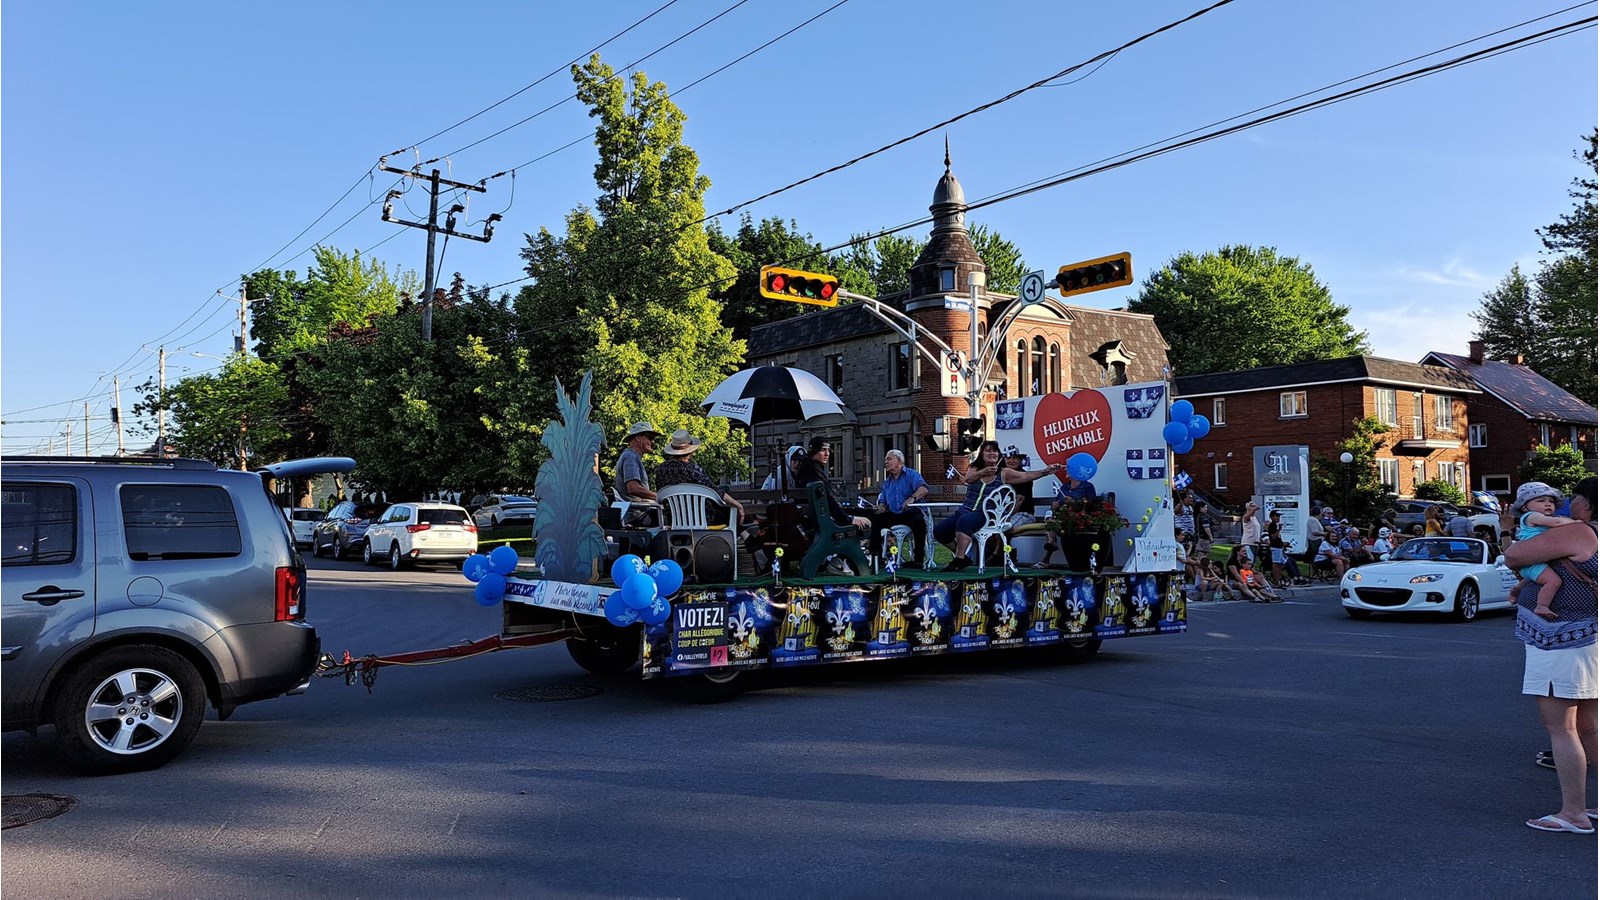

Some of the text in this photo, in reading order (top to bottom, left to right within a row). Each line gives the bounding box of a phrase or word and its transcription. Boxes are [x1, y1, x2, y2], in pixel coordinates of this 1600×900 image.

[1043, 409, 1101, 438] HEUREUX
[1046, 428, 1105, 455] ENSEMBLE
[678, 607, 724, 628] VOTEZ!
[677, 640, 691, 648] COUP
[691, 639, 698, 647] DE
[678, 628, 724, 638] CHAR ALLÉGORIQUE
